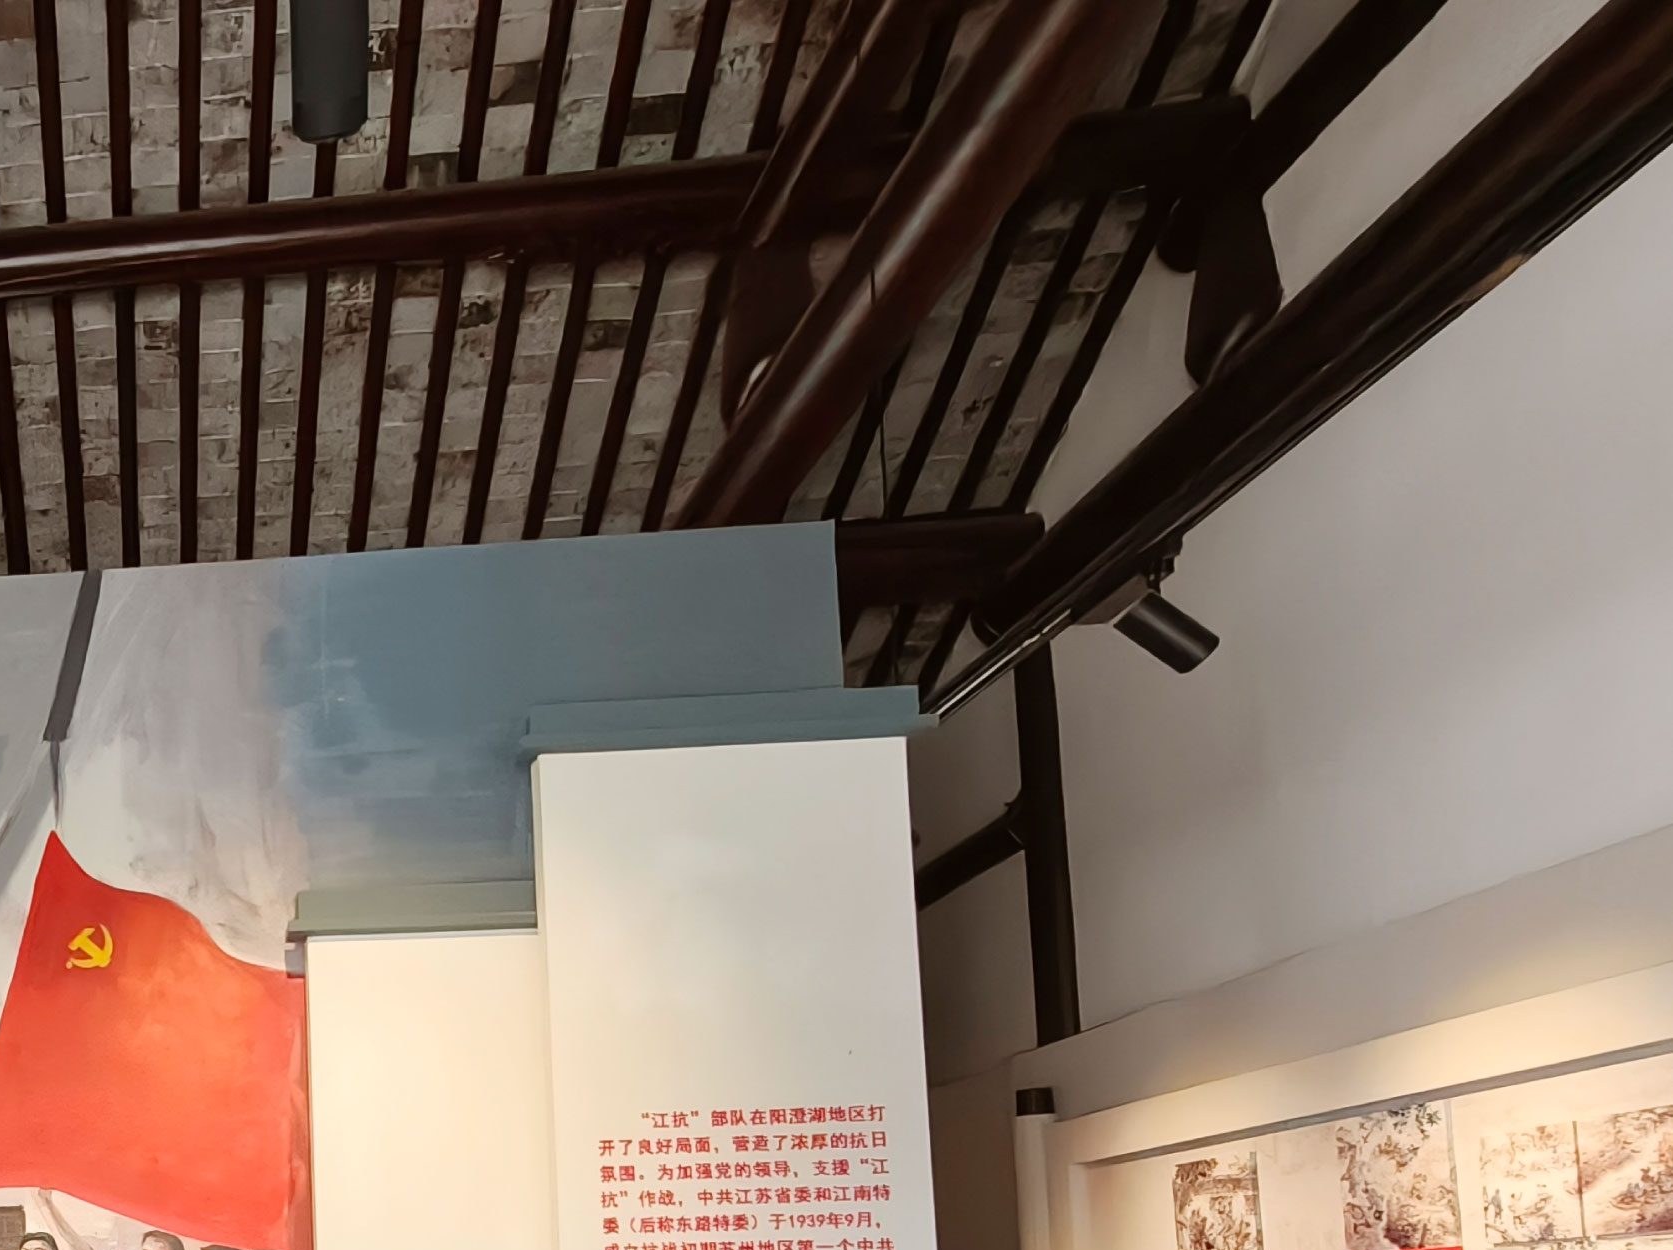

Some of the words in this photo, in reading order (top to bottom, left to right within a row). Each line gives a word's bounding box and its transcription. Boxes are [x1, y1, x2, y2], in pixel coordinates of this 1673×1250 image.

[641, 1104, 886, 1129] “江抗”部队在阳澄湖地区打
[599, 1131, 888, 1157] 开了良好局面，营造了浓厚的抗日
[600, 1158, 889, 1183] 氛围。为加强党的领导，支援“江
[601, 1184, 891, 1209] 抗”作战，中共江苏省委和江南特
[603, 1212, 882, 1234] 委（后称东路特委）于1939年9月，
